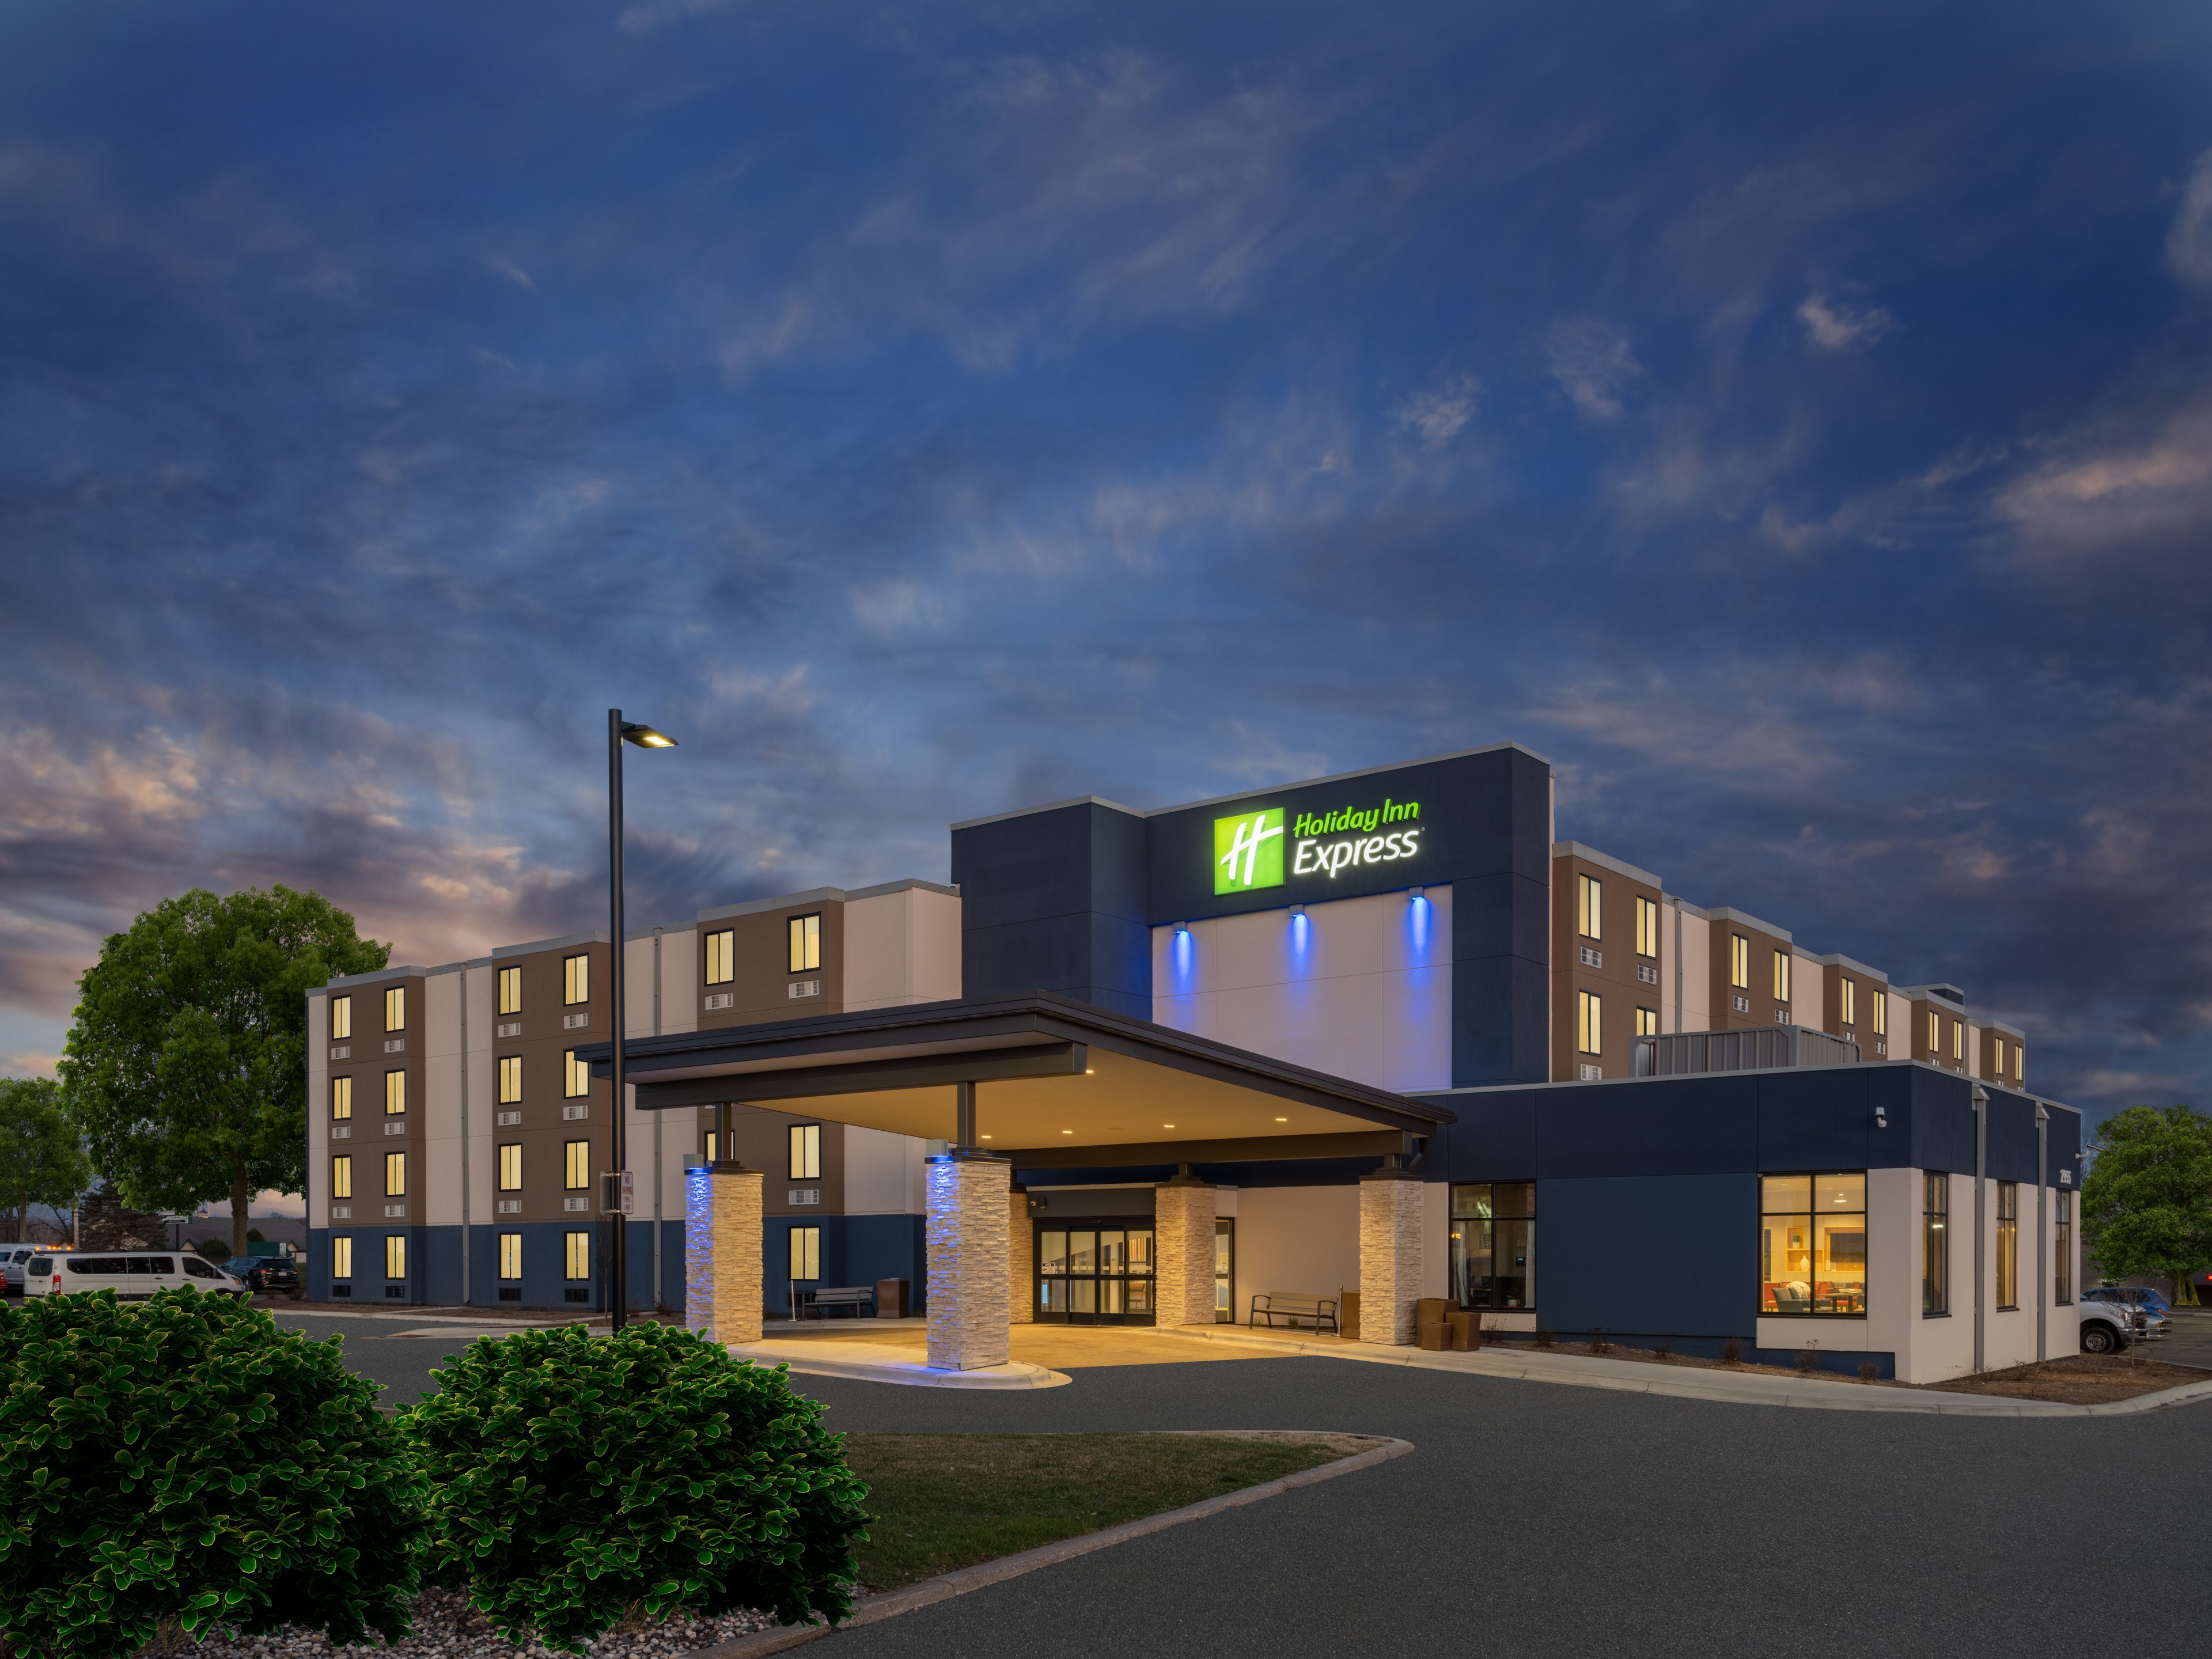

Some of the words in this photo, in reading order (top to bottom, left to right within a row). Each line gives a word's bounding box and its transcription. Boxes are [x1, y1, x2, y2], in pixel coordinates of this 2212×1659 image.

[1293, 806, 1380, 838] Holiday
[1382, 798, 1422, 824] Inn
[1294, 830, 1420, 878] Express
[622, 1185, 633, 1194] PARKING
[625, 1176, 630, 1184] NO
